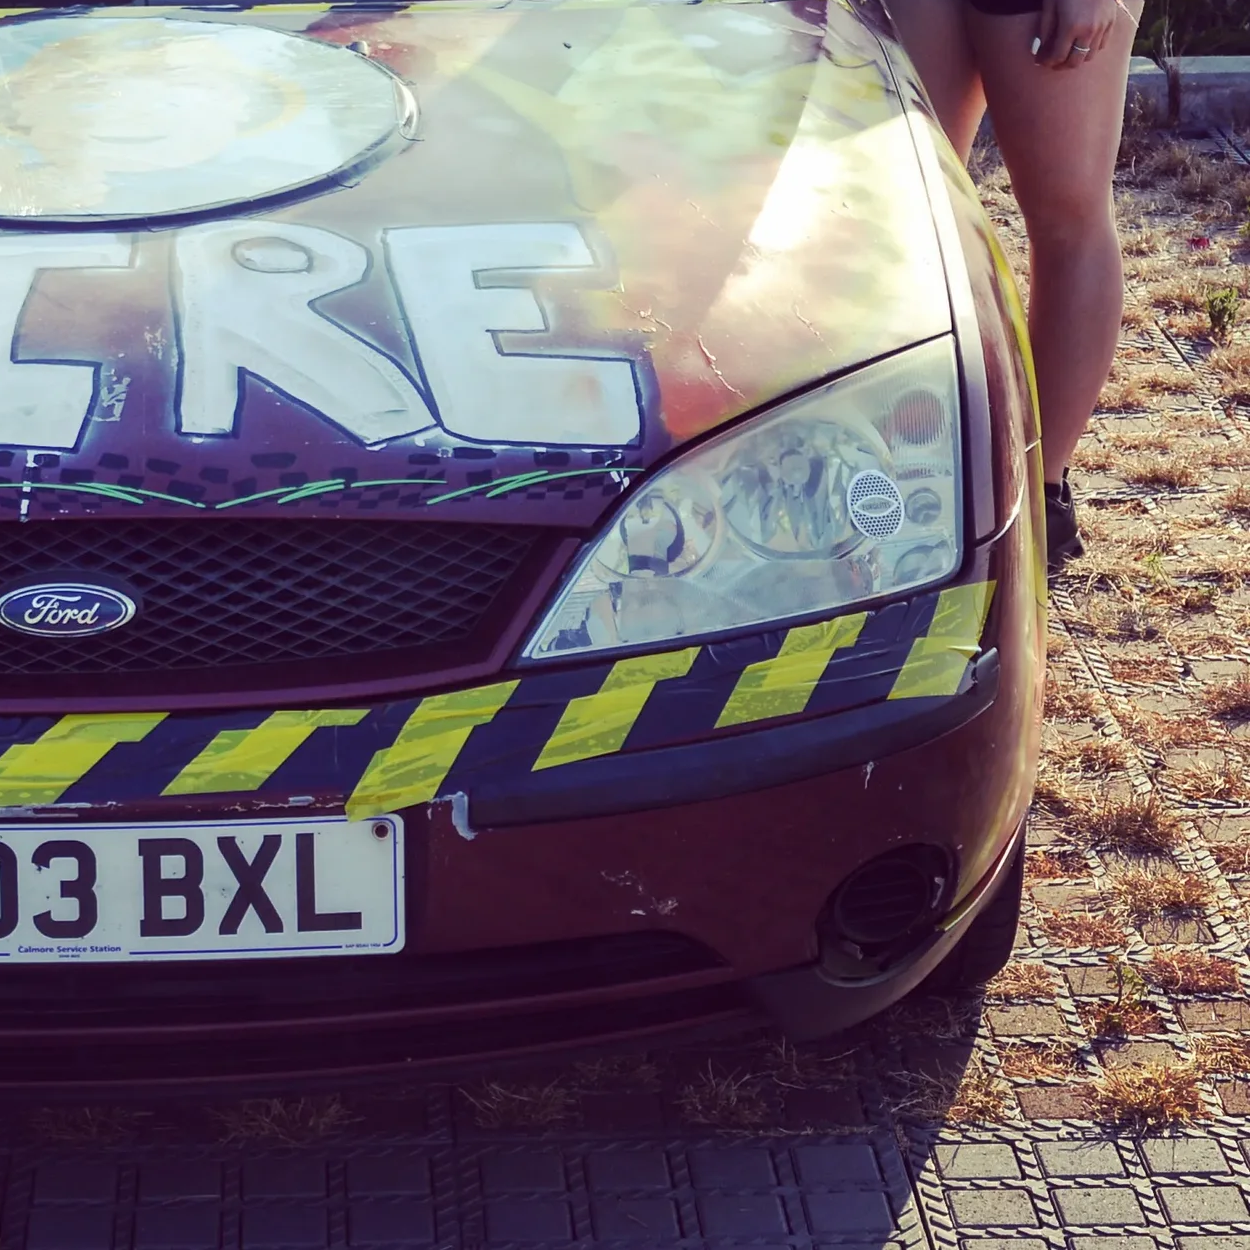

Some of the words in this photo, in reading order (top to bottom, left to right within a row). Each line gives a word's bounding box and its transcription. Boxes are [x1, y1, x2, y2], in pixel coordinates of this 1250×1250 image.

[24, 594, 101, 625] Ford
[138, 832, 362, 938] BXL
[18, 945, 54, 953] Calmore
[56, 945, 88, 953] Service
